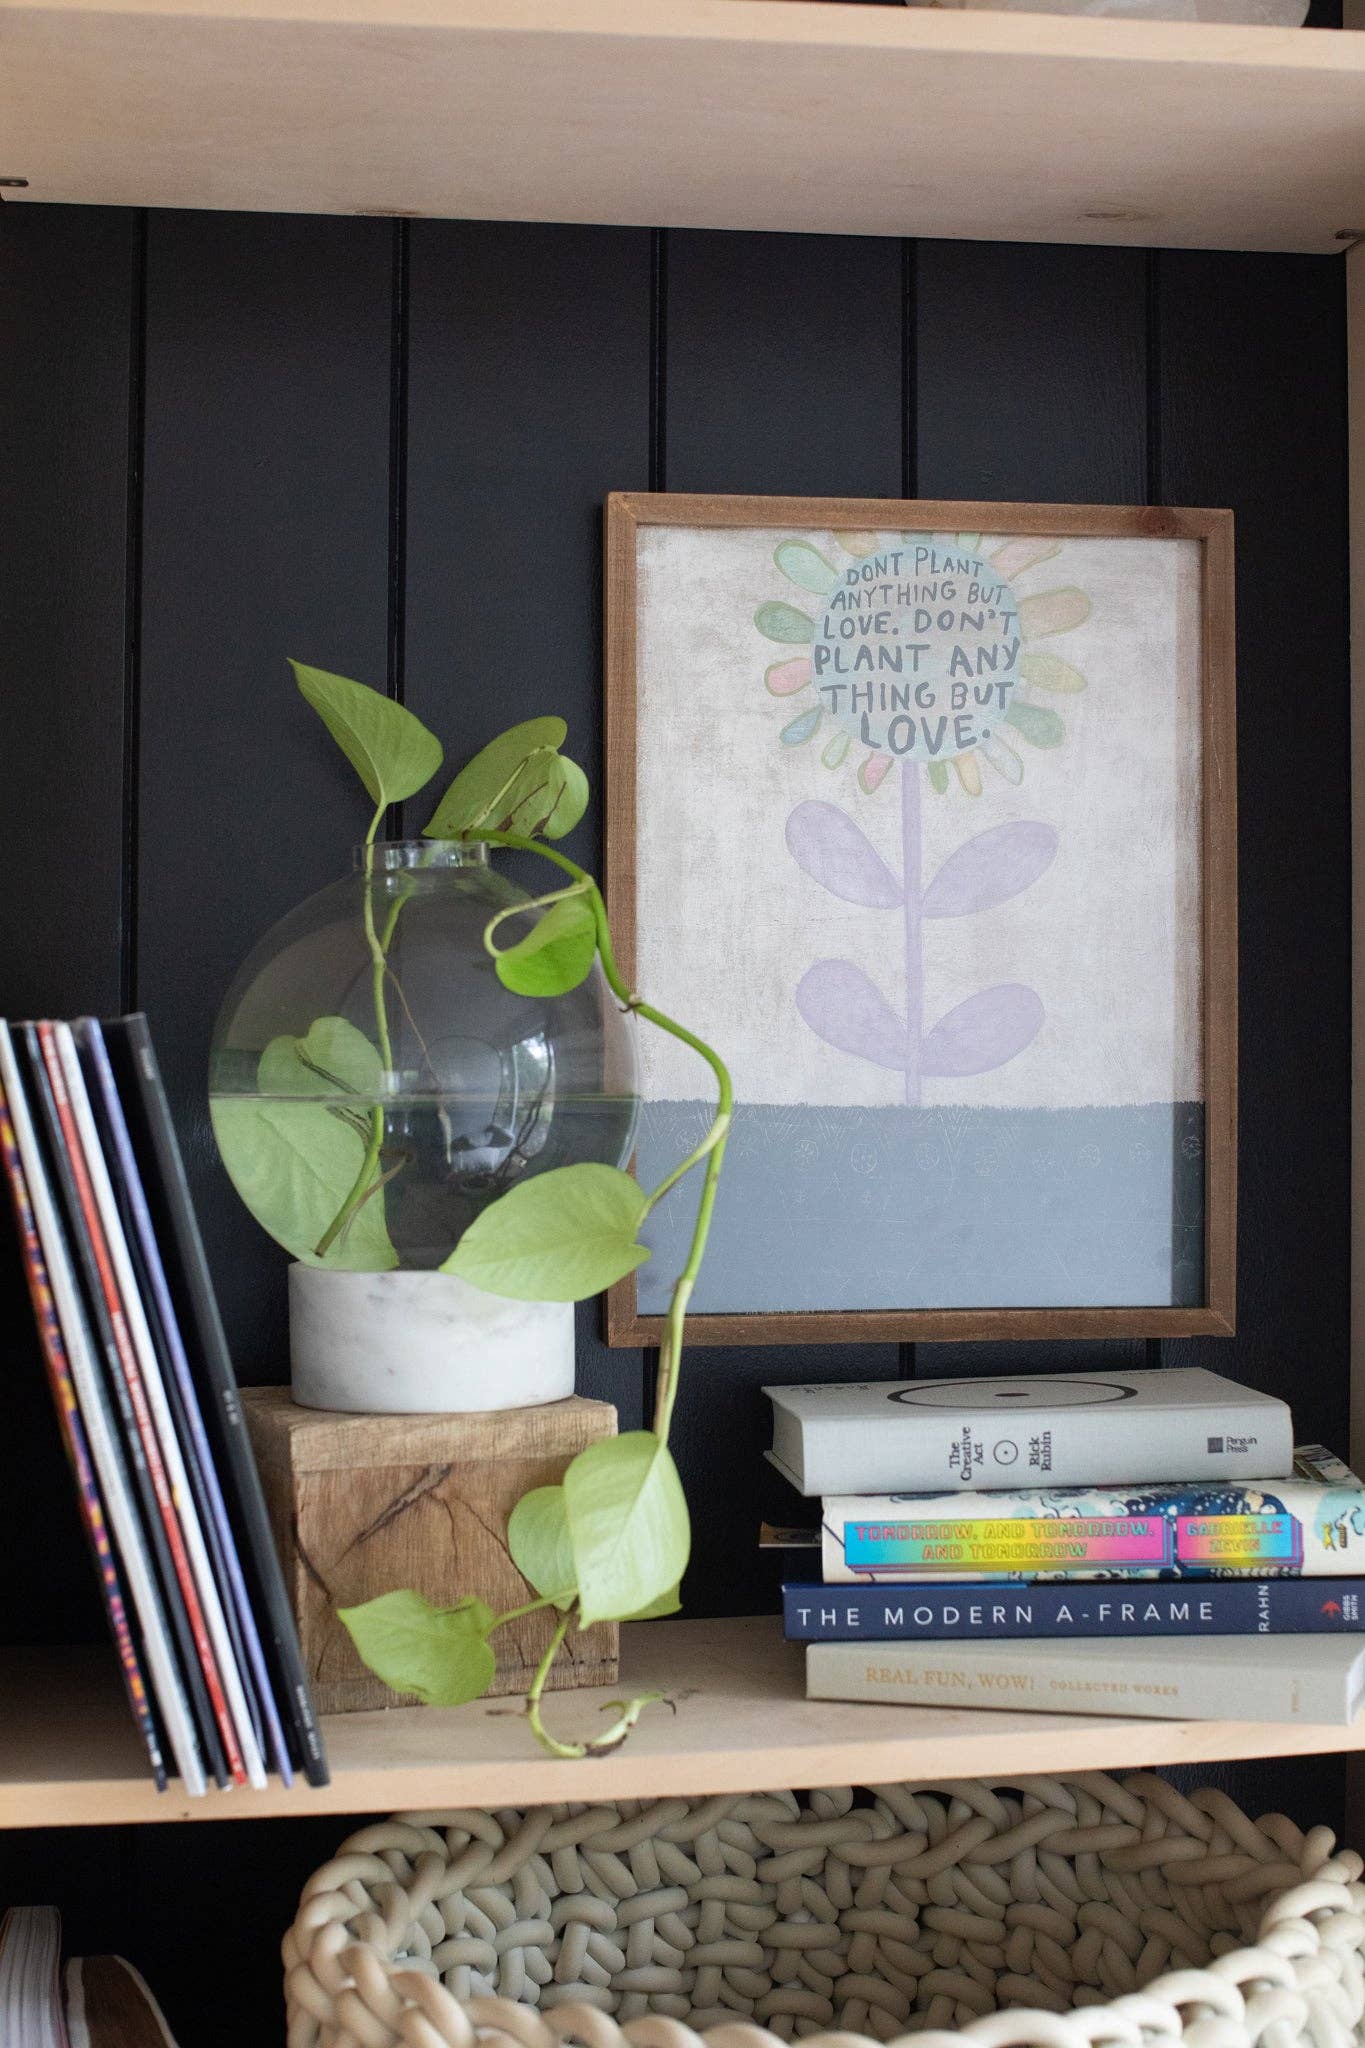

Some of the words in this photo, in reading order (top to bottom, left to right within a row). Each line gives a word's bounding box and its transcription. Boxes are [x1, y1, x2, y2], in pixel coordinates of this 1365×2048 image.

[846, 552, 904, 586] DONT
[915, 547, 984, 577] PLANT
[830, 580, 957, 611] ANYTHING
[967, 583, 1009, 606] BUT
[823, 610, 899, 640] LOVE.
[914, 608, 1018, 636] DON'T
[814, 643, 931, 675] PLANT
[950, 637, 1021, 678] ANY
[820, 681, 937, 715] THING
[951, 681, 1015, 710] BUT
[860, 711, 992, 756] LOVE.
[949, 1442, 960, 1469] The
[960, 1426, 972, 1481] Creative
[973, 1443, 984, 1465] Act
[1029, 1437, 1040, 1466] Rick
[1041, 1430, 1052, 1471] Rubin
[984, 1523, 1025, 1539] AND
[922, 1544, 964, 1560] AND
[971, 1541, 1088, 1559] TOMORROW
[797, 1607, 860, 1627] THE
[884, 1604, 1034, 1626] MODERN
[1055, 1602, 1213, 1624] A-FRAME
[1257, 1585, 1270, 1632] RAHN
[1351, 1594, 1359, 1621] SMITH
[866, 1667, 918, 1684] REAL
[924, 1669, 972, 1690] FUN,
[1050, 1679, 1127, 1694] COLLECTED
[1133, 1683, 1179, 1696] WORKS
